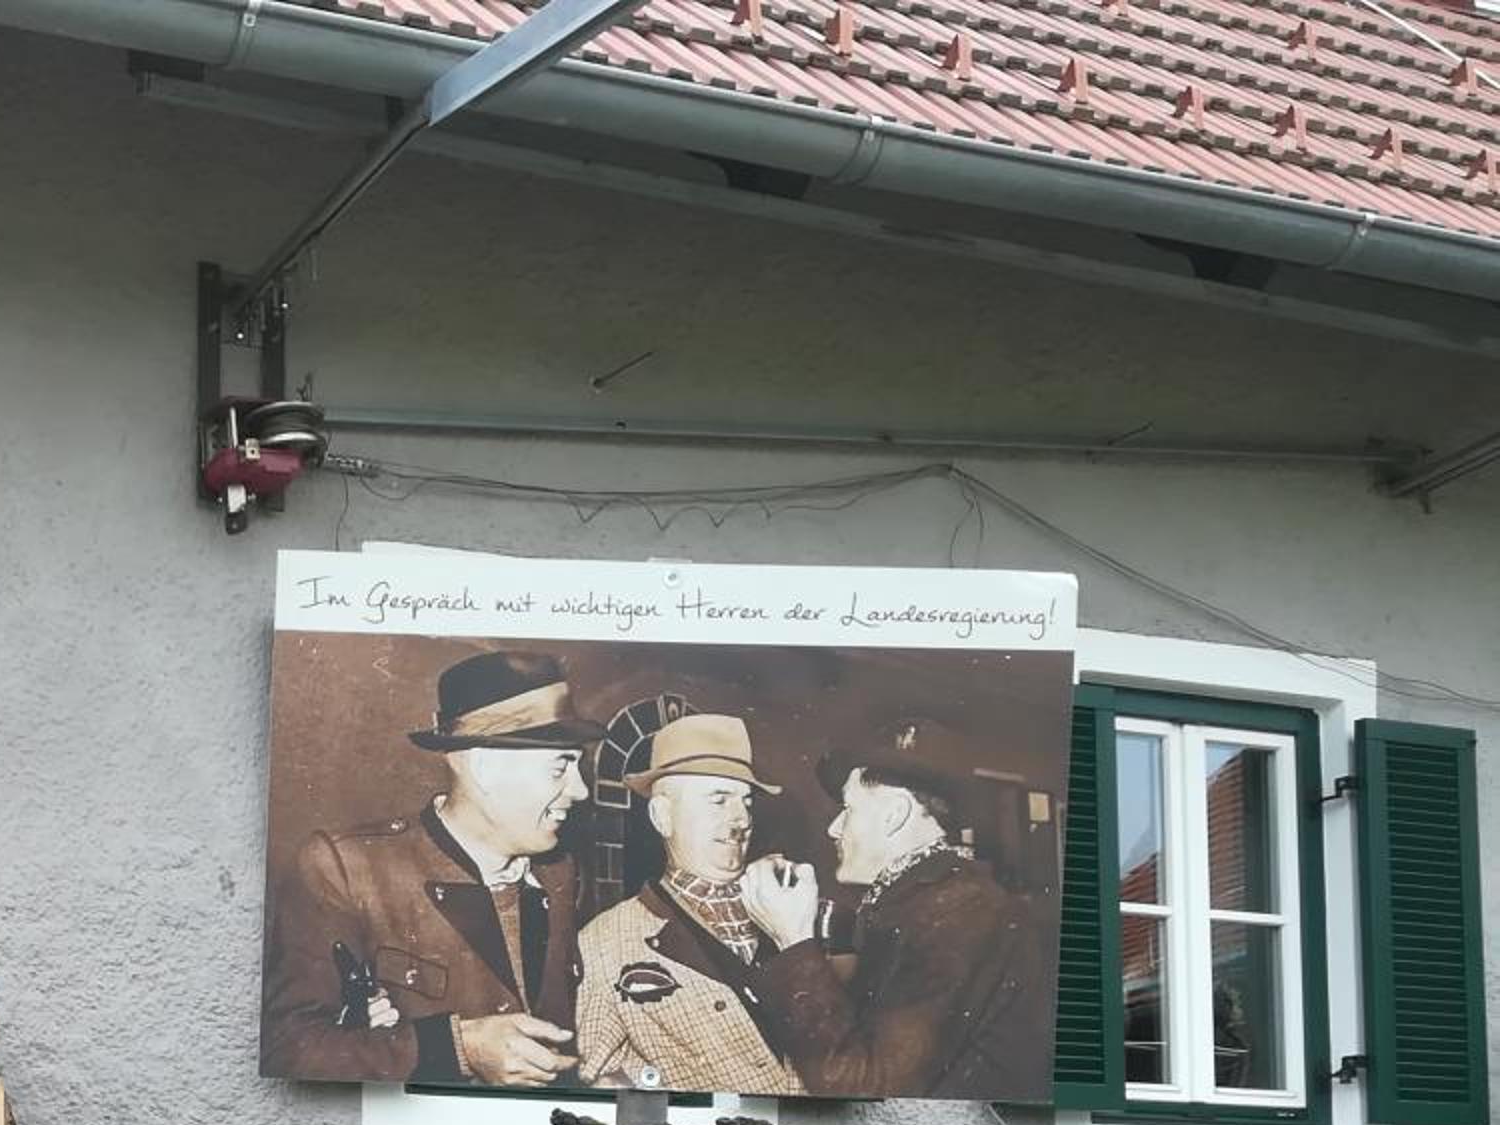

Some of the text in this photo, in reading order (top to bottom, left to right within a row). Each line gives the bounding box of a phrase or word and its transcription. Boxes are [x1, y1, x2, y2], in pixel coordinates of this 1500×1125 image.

[297, 575, 1058, 640] Im Gespräch mit wichtigen Herren der Landesregierung!
